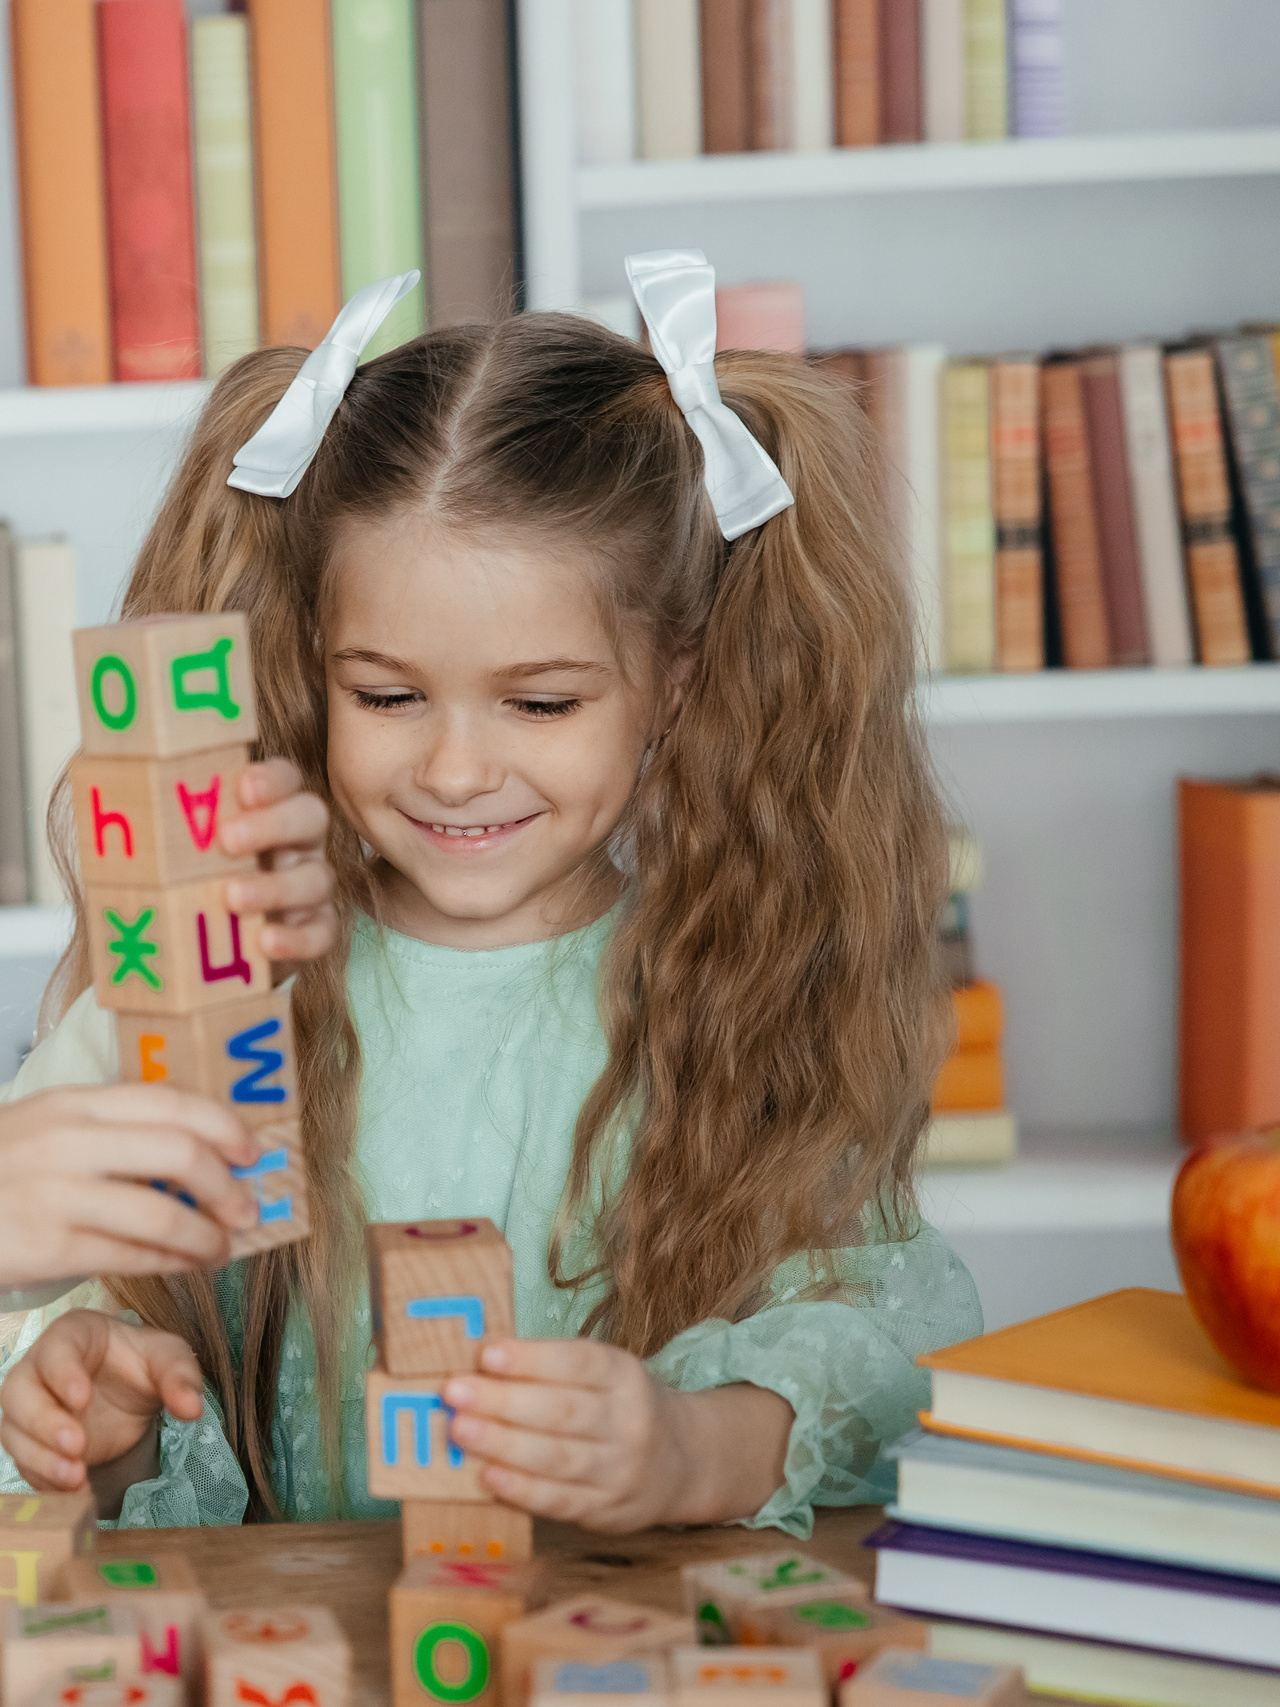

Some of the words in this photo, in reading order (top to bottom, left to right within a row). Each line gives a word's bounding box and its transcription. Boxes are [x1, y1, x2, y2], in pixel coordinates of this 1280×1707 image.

[90, 656, 136, 732] О
[170, 638, 240, 720] Д
[176, 773, 221, 853] А
[104, 908, 163, 991] Ж
[197, 912, 251, 985] Ц
[414, 1620, 491, 1704] О
